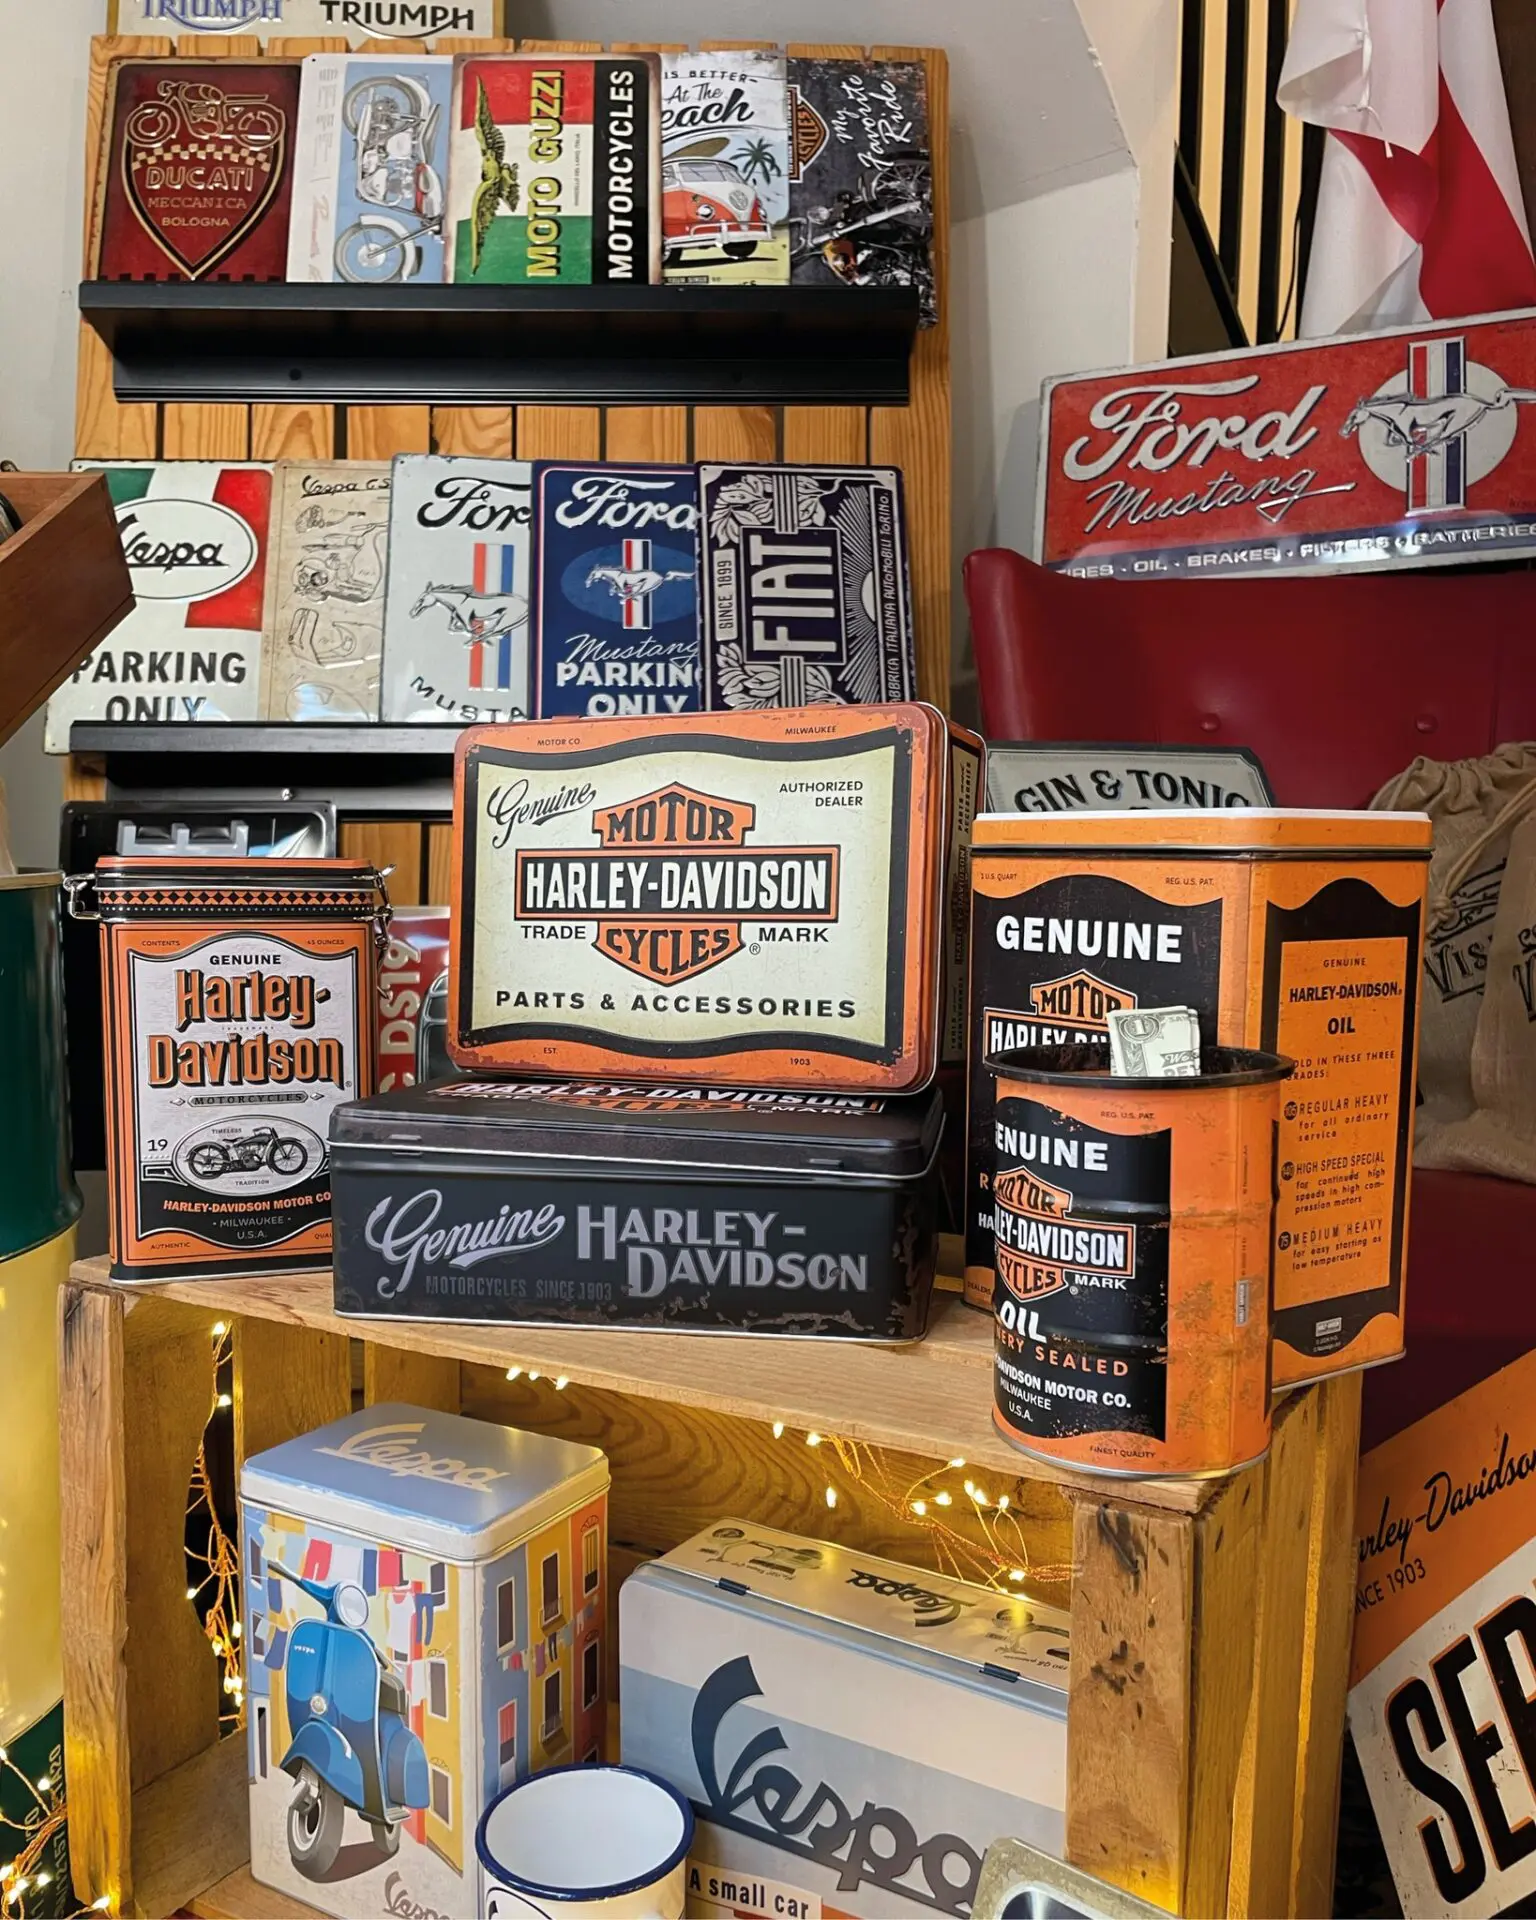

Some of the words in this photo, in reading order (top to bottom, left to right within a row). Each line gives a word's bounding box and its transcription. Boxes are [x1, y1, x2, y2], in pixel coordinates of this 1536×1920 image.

[141, 0, 284, 24] TRIUMPH
[319, 0, 475, 34] TRIUMPH
[664, 84, 689, 104] At
[692, 82, 724, 101] The
[528, 70, 564, 164] GUZZI
[868, 80, 912, 144] Ride
[145, 166, 254, 192] DUCATI
[608, 70, 634, 279] MOTORCYCLES
[148, 197, 247, 209] MECCANICA
[162, 216, 231, 227] BOLOGNA
[526, 177, 562, 278] MOTO
[1063, 374, 1327, 481] Ford
[300, 474, 358, 498] Vespa
[1084, 469, 1357, 533] Mustang
[119, 514, 230, 573] Vespa
[1134, 560, 1167, 573] OIL
[1187, 547, 1281, 567] BRAKES
[717, 560, 733, 588] 1899
[748, 533, 838, 654] FIAT
[718, 594, 734, 630] SINCE
[884, 602, 899, 653] ITALIANA
[71, 651, 247, 684] PARKING
[557, 661, 699, 688] PARKIN
[785, 726, 838, 735] MILWAUKEE
[779, 781, 863, 794] AUTHORIZED
[1014, 774, 1088, 812] GIN
[1090, 769, 1121, 800] &
[487, 779, 597, 849] Genuine
[815, 796, 863, 807] DEALER
[607, 793, 734, 842] MOTOR
[525, 859, 827, 911] HARLEY-DAVIDSON
[142, 939, 181, 947] CONTENTS
[521, 925, 586, 941] TRADE
[758, 927, 829, 943] MARK
[996, 915, 1183, 963] GENUINE
[209, 954, 282, 966] GENUINE
[605, 927, 731, 977] CYCLES
[1323, 957, 1367, 968] GENUINE
[175, 969, 332, 1033] Harley-
[379, 938, 421, 1055] DS19
[496, 991, 585, 1010] PARTS
[600, 994, 615, 1011] &
[631, 994, 857, 1018] ACCESSORIES
[1289, 981, 1399, 1002] HARLEY-DAVIDSON
[1327, 1017, 1355, 1034] OIL
[147, 1032, 347, 1091] Davidson
[789, 1058, 811, 1066] 1903
[1317, 1056, 1328, 1065] IN
[1333, 1053, 1361, 1064] THESE
[1366, 1050, 1395, 1060] THREE
[194, 1093, 303, 1106] MOTORCYCLES
[455, 1082, 865, 1108] HARLEY-DAVIDSON
[1299, 1098, 1349, 1115] REGULAR
[1354, 1094, 1389, 1109] HEAVY
[1299, 1120, 1314, 1129] for
[1323, 1117, 1337, 1127] all
[1344, 1112, 1390, 1124] ordinary
[147, 1138, 169, 1152] 19
[1299, 1130, 1337, 1141] service
[1296, 1161, 1318, 1175] HIGH
[1320, 1157, 1348, 1171] SPEED
[1350, 1152, 1385, 1167] SPECIAL
[1296, 1180, 1309, 1189] for
[1318, 1171, 1359, 1186] continued
[1368, 1168, 1386, 1179] high
[163, 1199, 271, 1213] HARLEY-DAVIDSON
[274, 1193, 313, 1210] MOTOR
[1295, 1189, 1325, 1202] speeds
[1330, 1187, 1338, 1195] in
[1342, 1184, 1360, 1195] high
[1295, 1201, 1331, 1215] pression
[1334, 1196, 1362, 1206] motors
[219, 1215, 285, 1227] MILWAUKEE
[1293, 1225, 1340, 1245] MEDIUM
[1347, 1218, 1383, 1235] HEAVY
[150, 1241, 191, 1250] AUTHENTIC
[236, 1229, 268, 1240] U.S.A.
[365, 1189, 566, 1299] Genuine
[576, 1204, 807, 1261] HARLEY-
[1292, 1262, 1307, 1271] low
[1311, 1252, 1361, 1267] temperature
[1293, 1249, 1305, 1259] for
[1311, 1246, 1330, 1256] easy
[1336, 1238, 1367, 1250] starting
[626, 1245, 868, 1298] DAVIDSON
[1074, 1274, 1127, 1291] MARK
[426, 1275, 527, 1297] MOTORCYCLES
[536, 1279, 574, 1299] SINCE
[579, 1281, 613, 1301] 1903
[1000, 1300, 1048, 1344] OIL
[1035, 1345, 1129, 1377] SEALED
[1044, 1380, 1098, 1404] MOTOR
[1102, 1392, 1132, 1409] CO.
[1008, 1400, 1034, 1422] U.S.A.
[312, 1423, 511, 1493] Vespa
[1119, 1449, 1156, 1459] QUALITY
[1358, 1432, 1536, 1565] rley-Davidso
[1387, 1558, 1426, 1592] 1903
[845, 1568, 976, 1628] Vespa
[690, 1655, 988, 1919] Vespa
[689, 1867, 701, 1892] A
[709, 1875, 765, 1909] small
[775, 1891, 809, 1920] car
